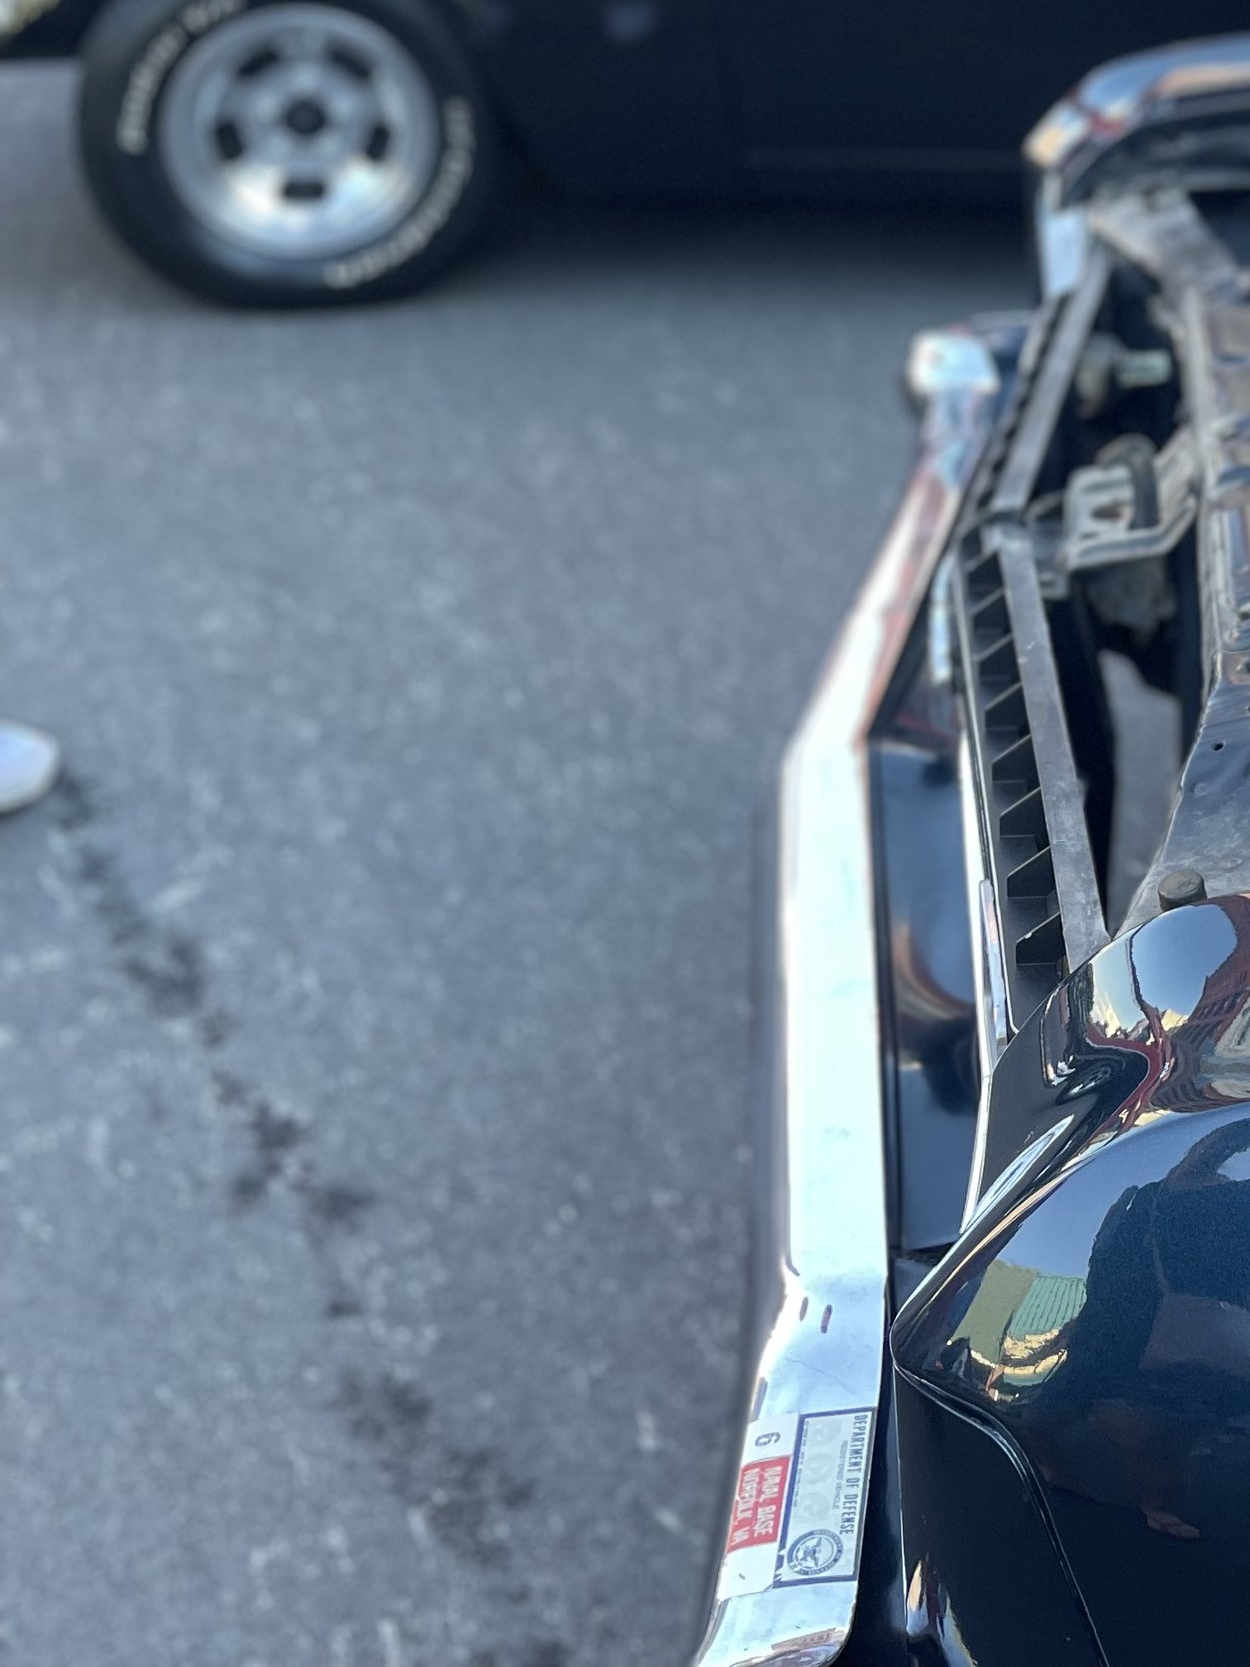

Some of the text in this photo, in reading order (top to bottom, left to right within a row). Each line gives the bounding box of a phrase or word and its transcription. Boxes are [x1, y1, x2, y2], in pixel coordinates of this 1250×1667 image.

[755, 1432, 780, 1447] 6
[840, 1414, 868, 1535] DEPARTMENT OF DEFENSE
[754, 1466, 782, 1537] NAVAL BASE
[731, 1526, 750, 1546] VA
